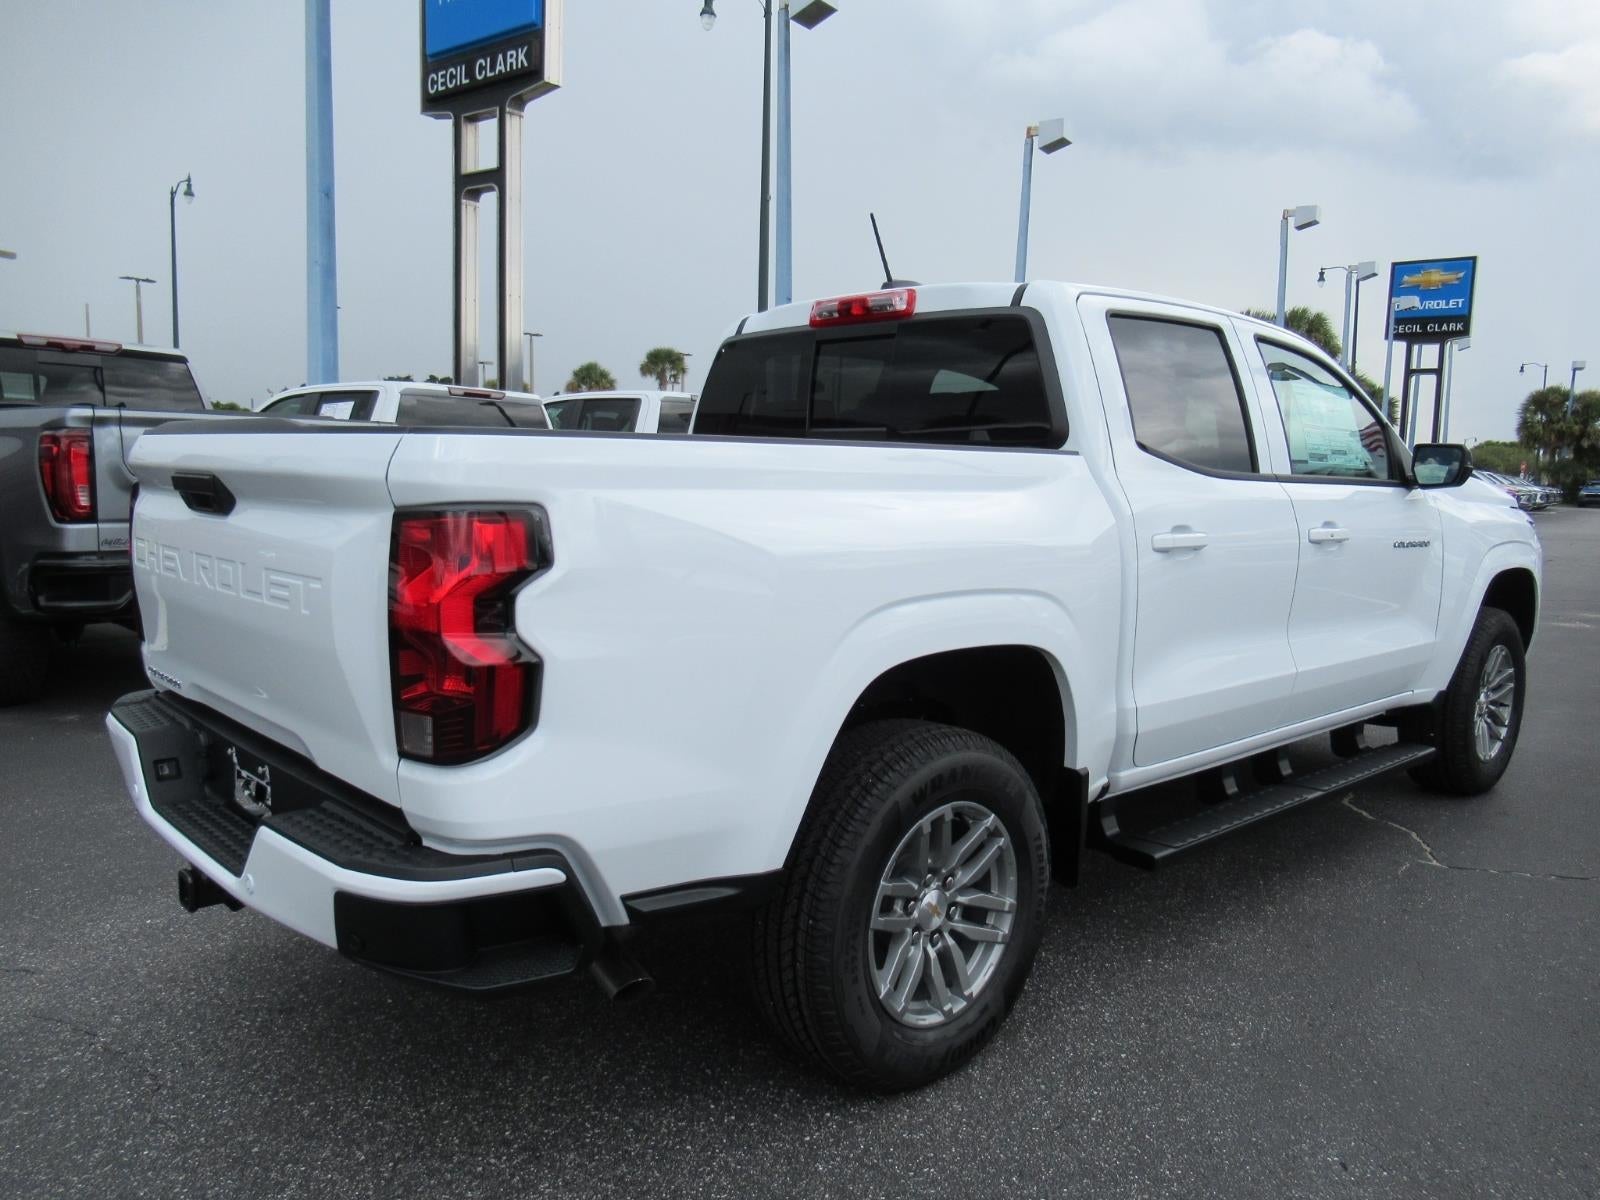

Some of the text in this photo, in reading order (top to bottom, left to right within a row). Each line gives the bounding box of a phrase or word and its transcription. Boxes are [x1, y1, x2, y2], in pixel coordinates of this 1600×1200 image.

[428, 46, 529, 94] CECIL CLARK
[1394, 298, 1465, 311] CVROLET
[1392, 322, 1464, 334] CECIL CLARK
[134, 537, 322, 615] CHEVROLET
